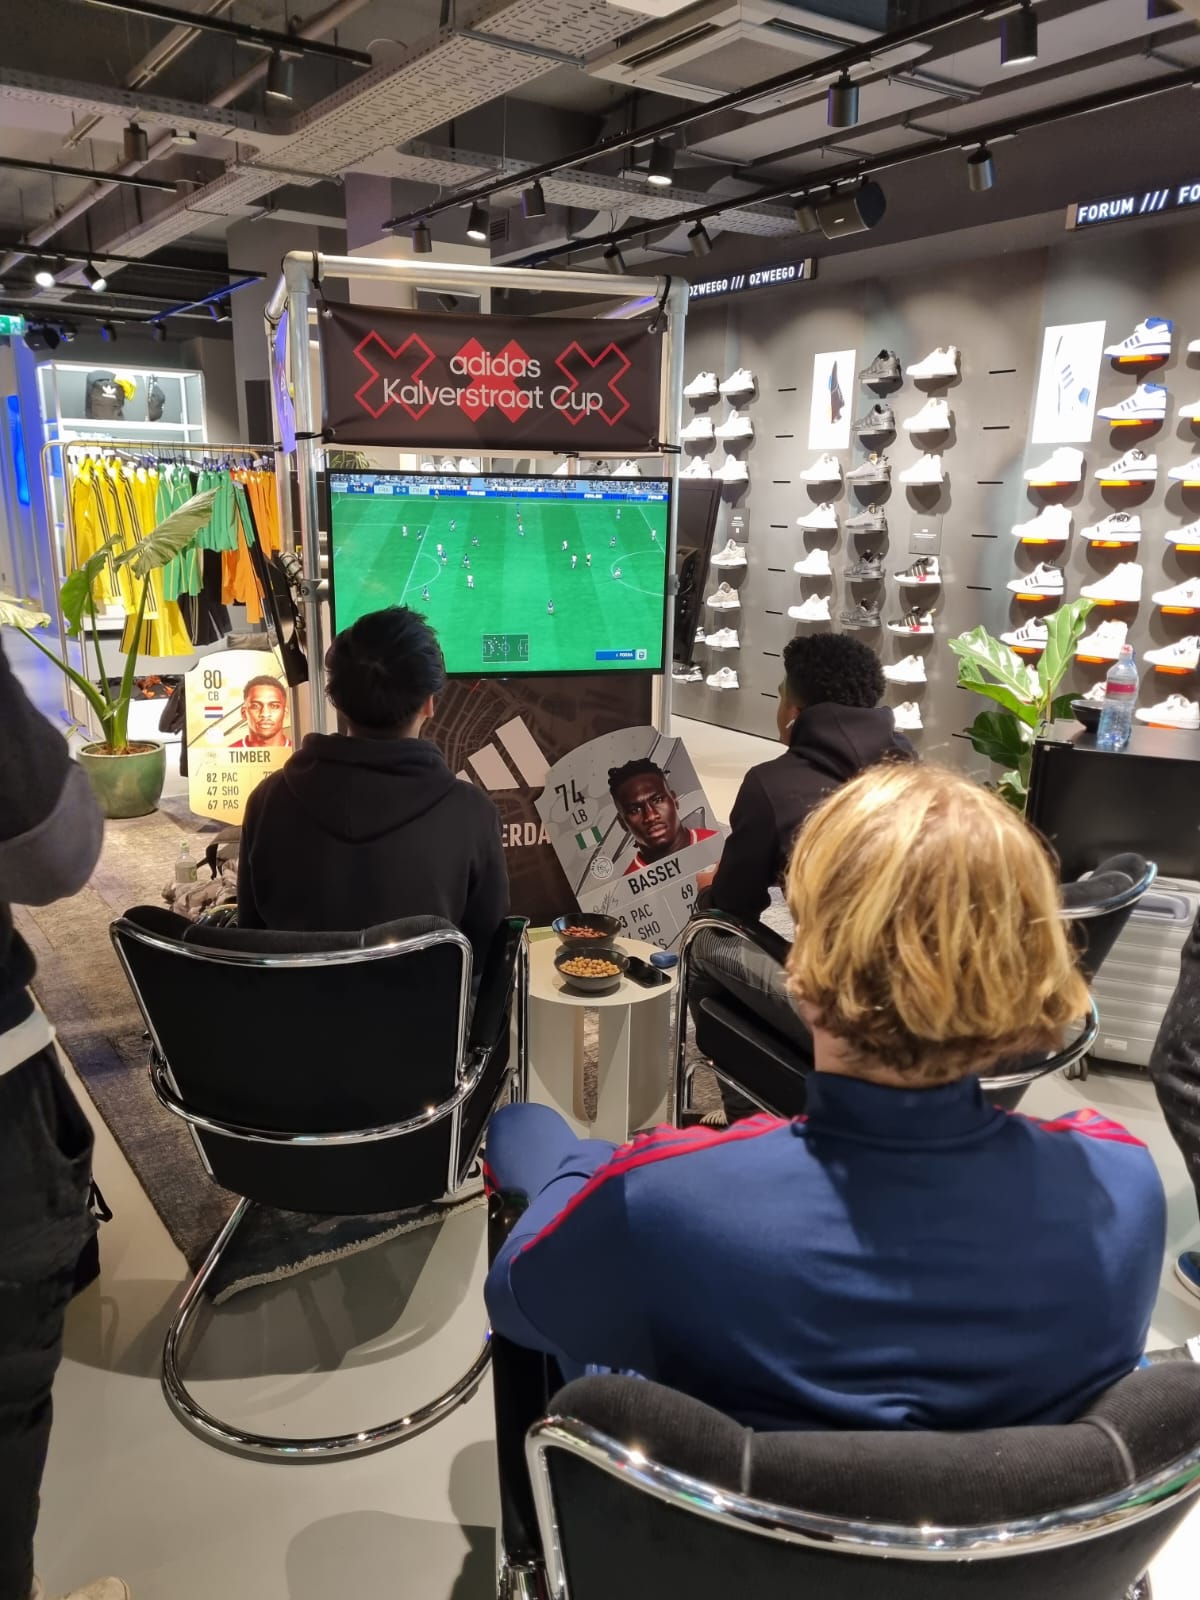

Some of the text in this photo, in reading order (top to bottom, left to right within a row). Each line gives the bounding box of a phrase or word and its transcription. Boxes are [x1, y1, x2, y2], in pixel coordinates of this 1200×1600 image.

[1077, 197, 1134, 224] FORUM
[1177, 184, 1200, 205] FO
[749, 266, 795, 286] OZWEEGO
[450, 351, 541, 378] adidas
[384, 378, 603, 415] Kalverstraat Cup
[203, 669, 223, 690] 80
[207, 691, 219, 702] CB
[229, 750, 271, 763] TIMBER
[206, 772, 217, 783] 82
[221, 772, 238, 783] PAC
[206, 786, 239, 796] 47 SHO
[555, 779, 585, 812] 74
[207, 799, 239, 810] 67 PAS
[571, 808, 588, 826] LB
[502, 822, 552, 848] ERDA
[628, 857, 682, 895] BASSEY
[630, 903, 653, 924] PAC
[681, 883, 693, 900] 69
[638, 920, 661, 940] SHO
